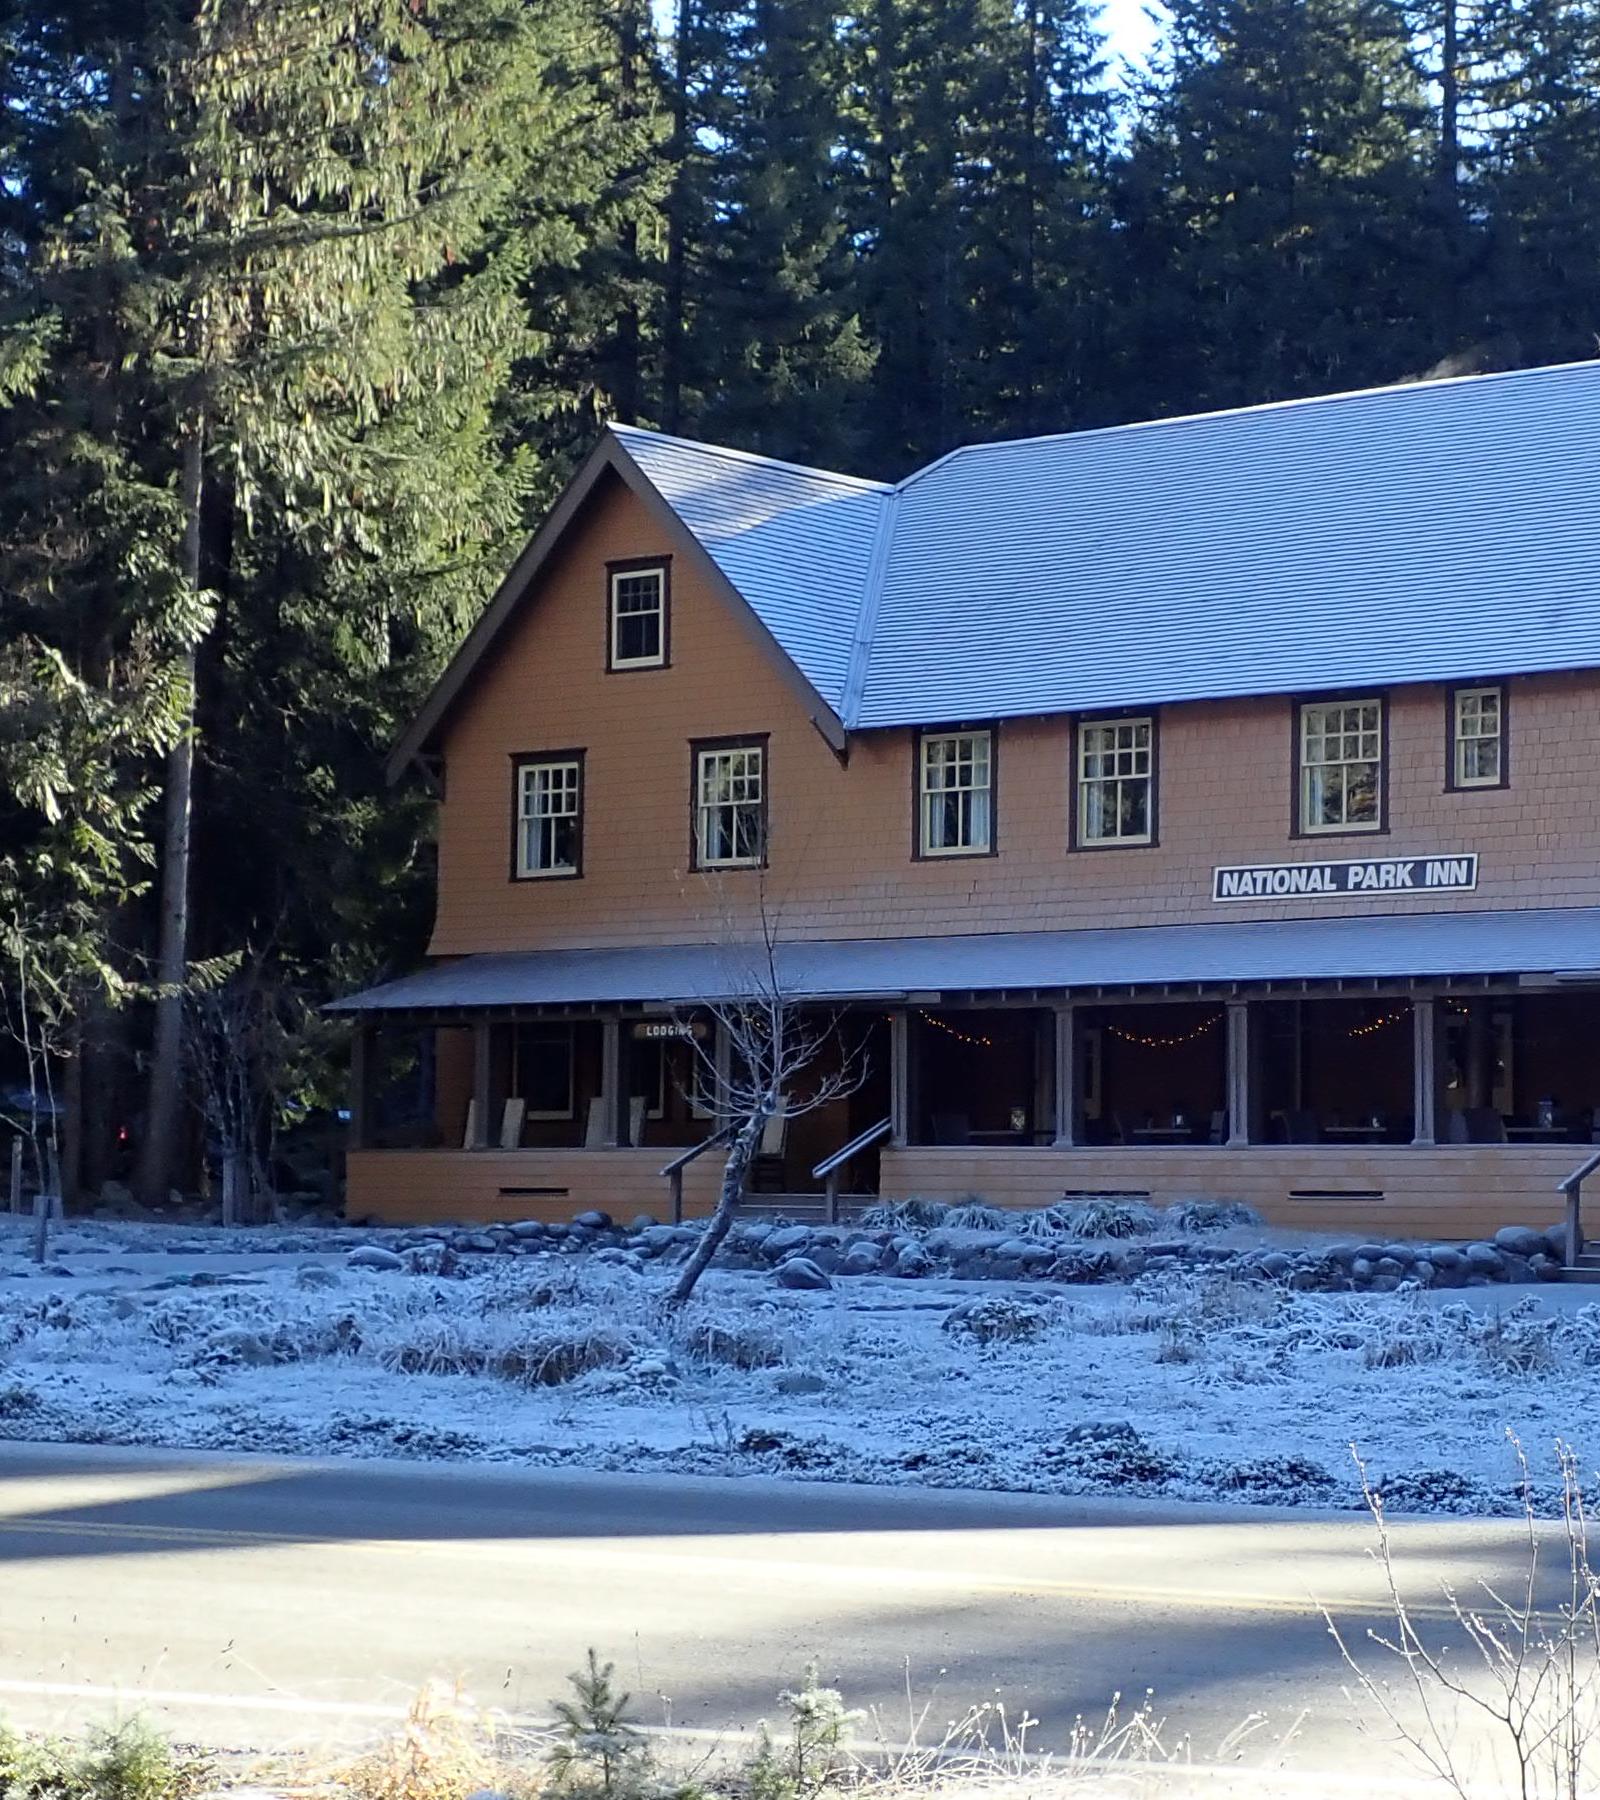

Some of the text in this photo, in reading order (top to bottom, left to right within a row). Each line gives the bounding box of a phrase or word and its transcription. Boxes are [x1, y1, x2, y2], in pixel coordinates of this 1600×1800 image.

[1221, 860, 1468, 896] NATIONAL PARK INN
